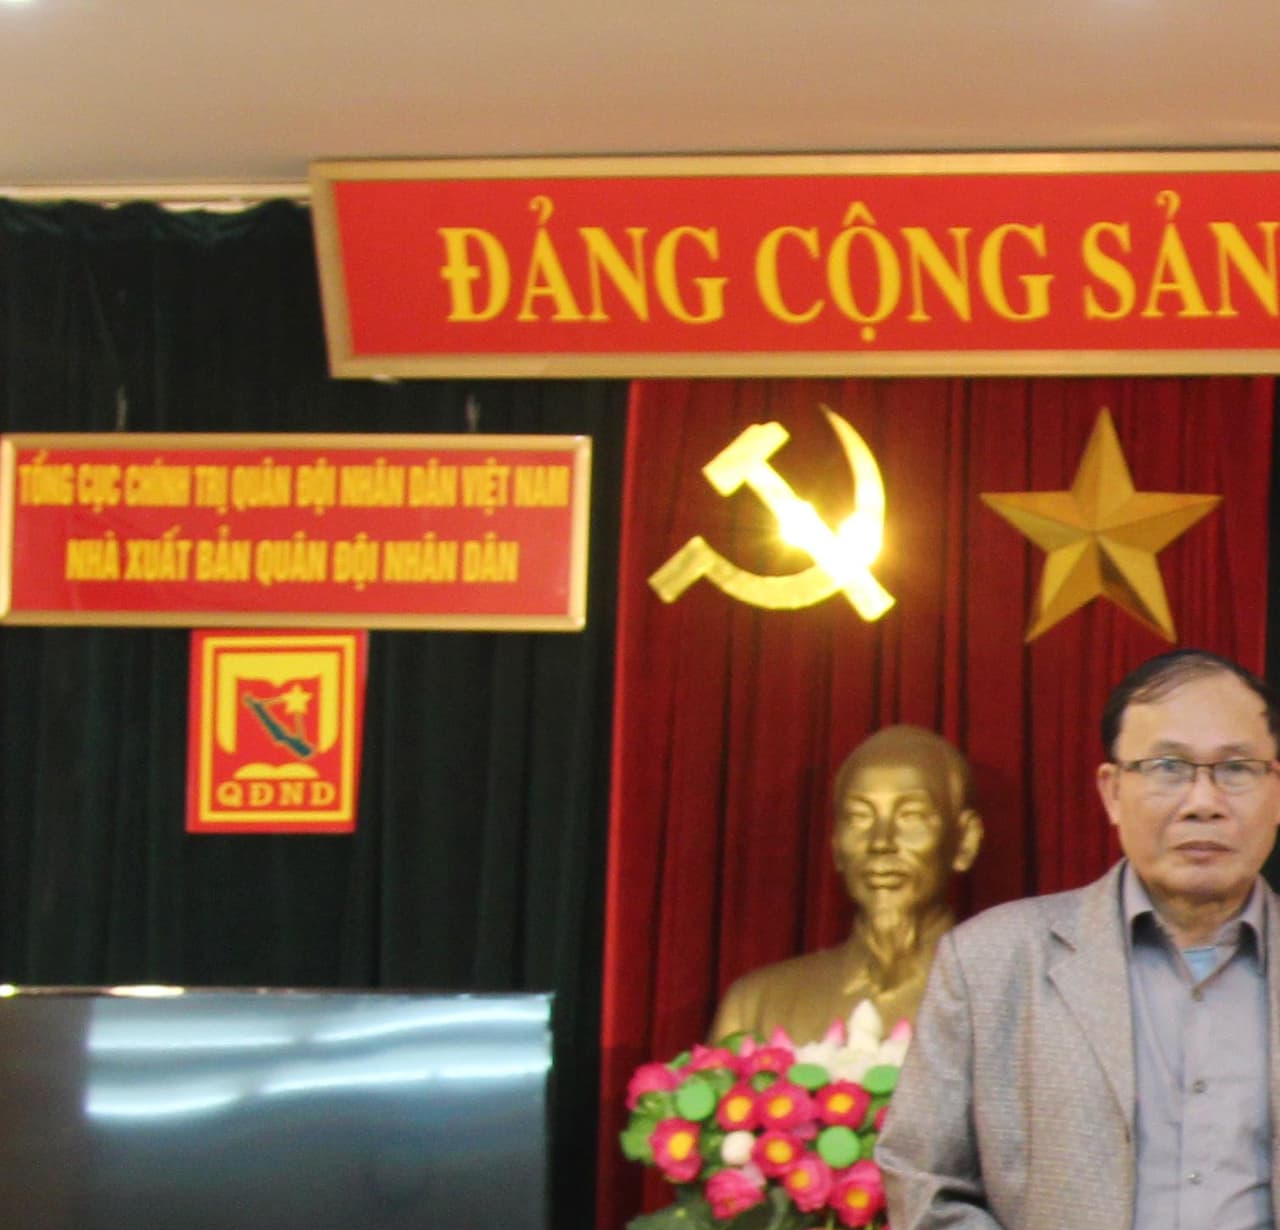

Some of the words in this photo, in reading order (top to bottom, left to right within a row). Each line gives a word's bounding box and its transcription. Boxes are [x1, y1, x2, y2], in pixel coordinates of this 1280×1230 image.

[438, 195, 728, 323] ĐẢNG
[755, 201, 1054, 341] CỘNG
[1081, 190, 1280, 320] SẢN
[231, 456, 292, 511] QUÂN
[340, 456, 404, 508] NHÂN
[408, 456, 456, 508] DÂN
[462, 456, 509, 516] VIỆT
[514, 465, 570, 508] NAM
[66, 529, 119, 581] NHÀ
[125, 525, 193, 581] XUẤT
[195, 524, 251, 582] BẢN
[255, 530, 328, 587] QUÂN
[332, 530, 379, 591] ĐỘI
[382, 530, 459, 583] NHÂN
[462, 530, 520, 583] DÂN
[217, 780, 337, 809] QĐND
